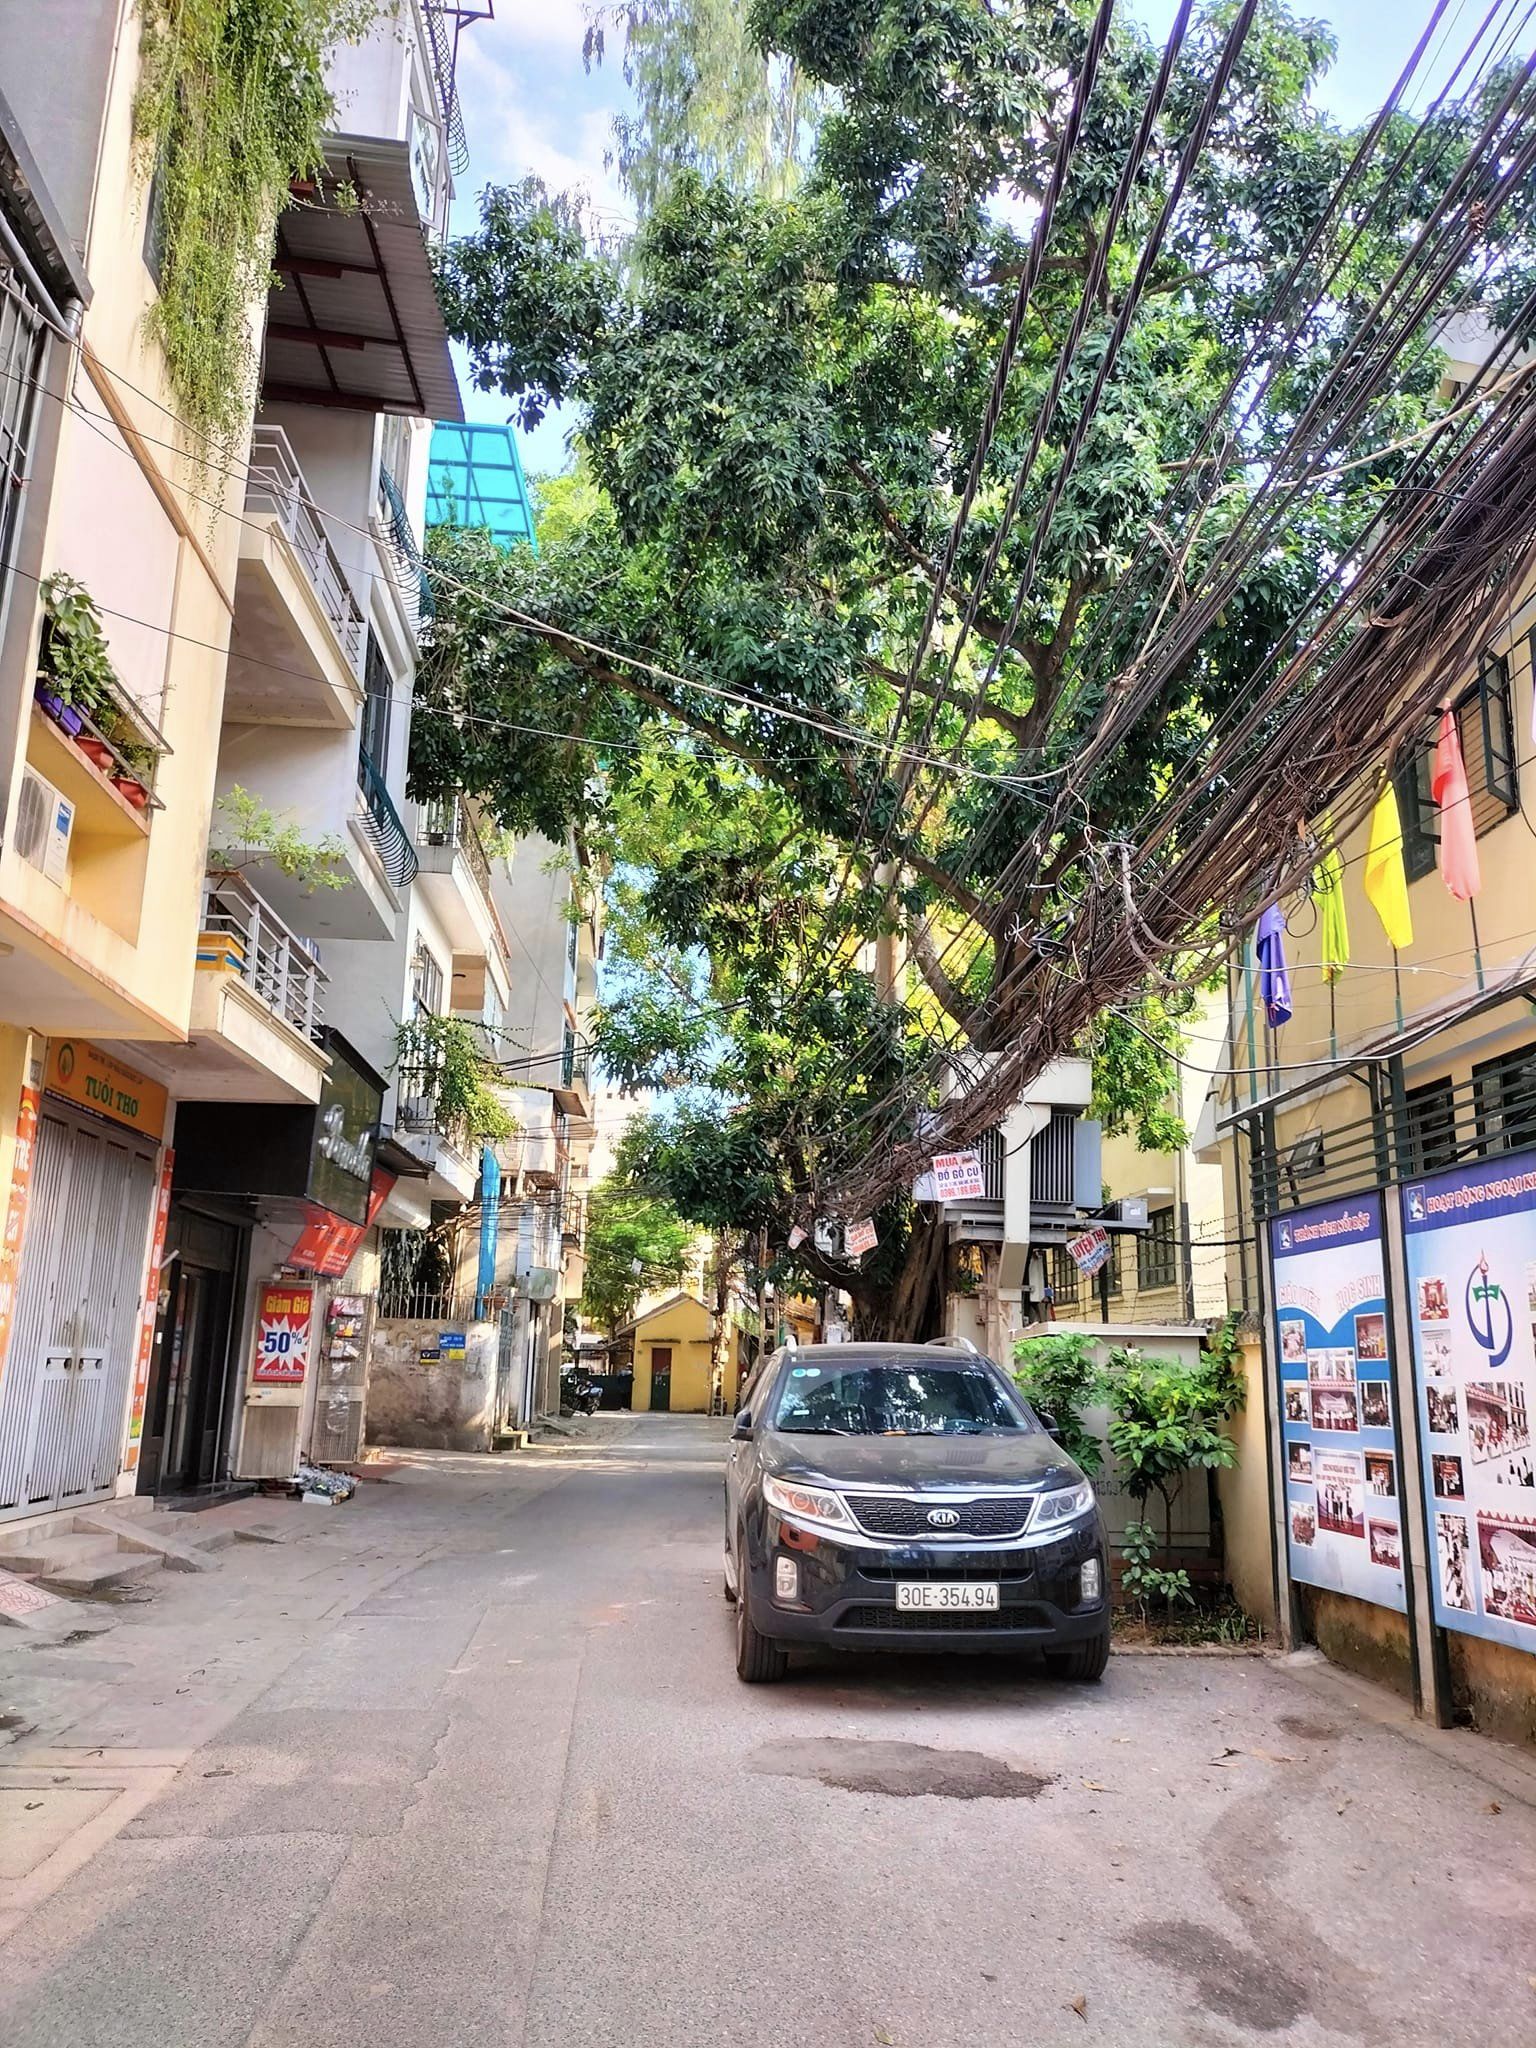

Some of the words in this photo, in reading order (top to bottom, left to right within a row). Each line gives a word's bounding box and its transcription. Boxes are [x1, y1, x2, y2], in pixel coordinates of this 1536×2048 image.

[935, 1156, 959, 1168] MUA
[1426, 1191, 1454, 1213] HOẠT
[1485, 1176, 1523, 1201] NGOẠI
[1358, 1274, 1383, 1300] SINH
[292, 1296, 310, 1314] Giá
[264, 1331, 303, 1353] 50%
[931, 1511, 955, 1524] KIA
[900, 1586, 996, 1607] 30E-354.94
